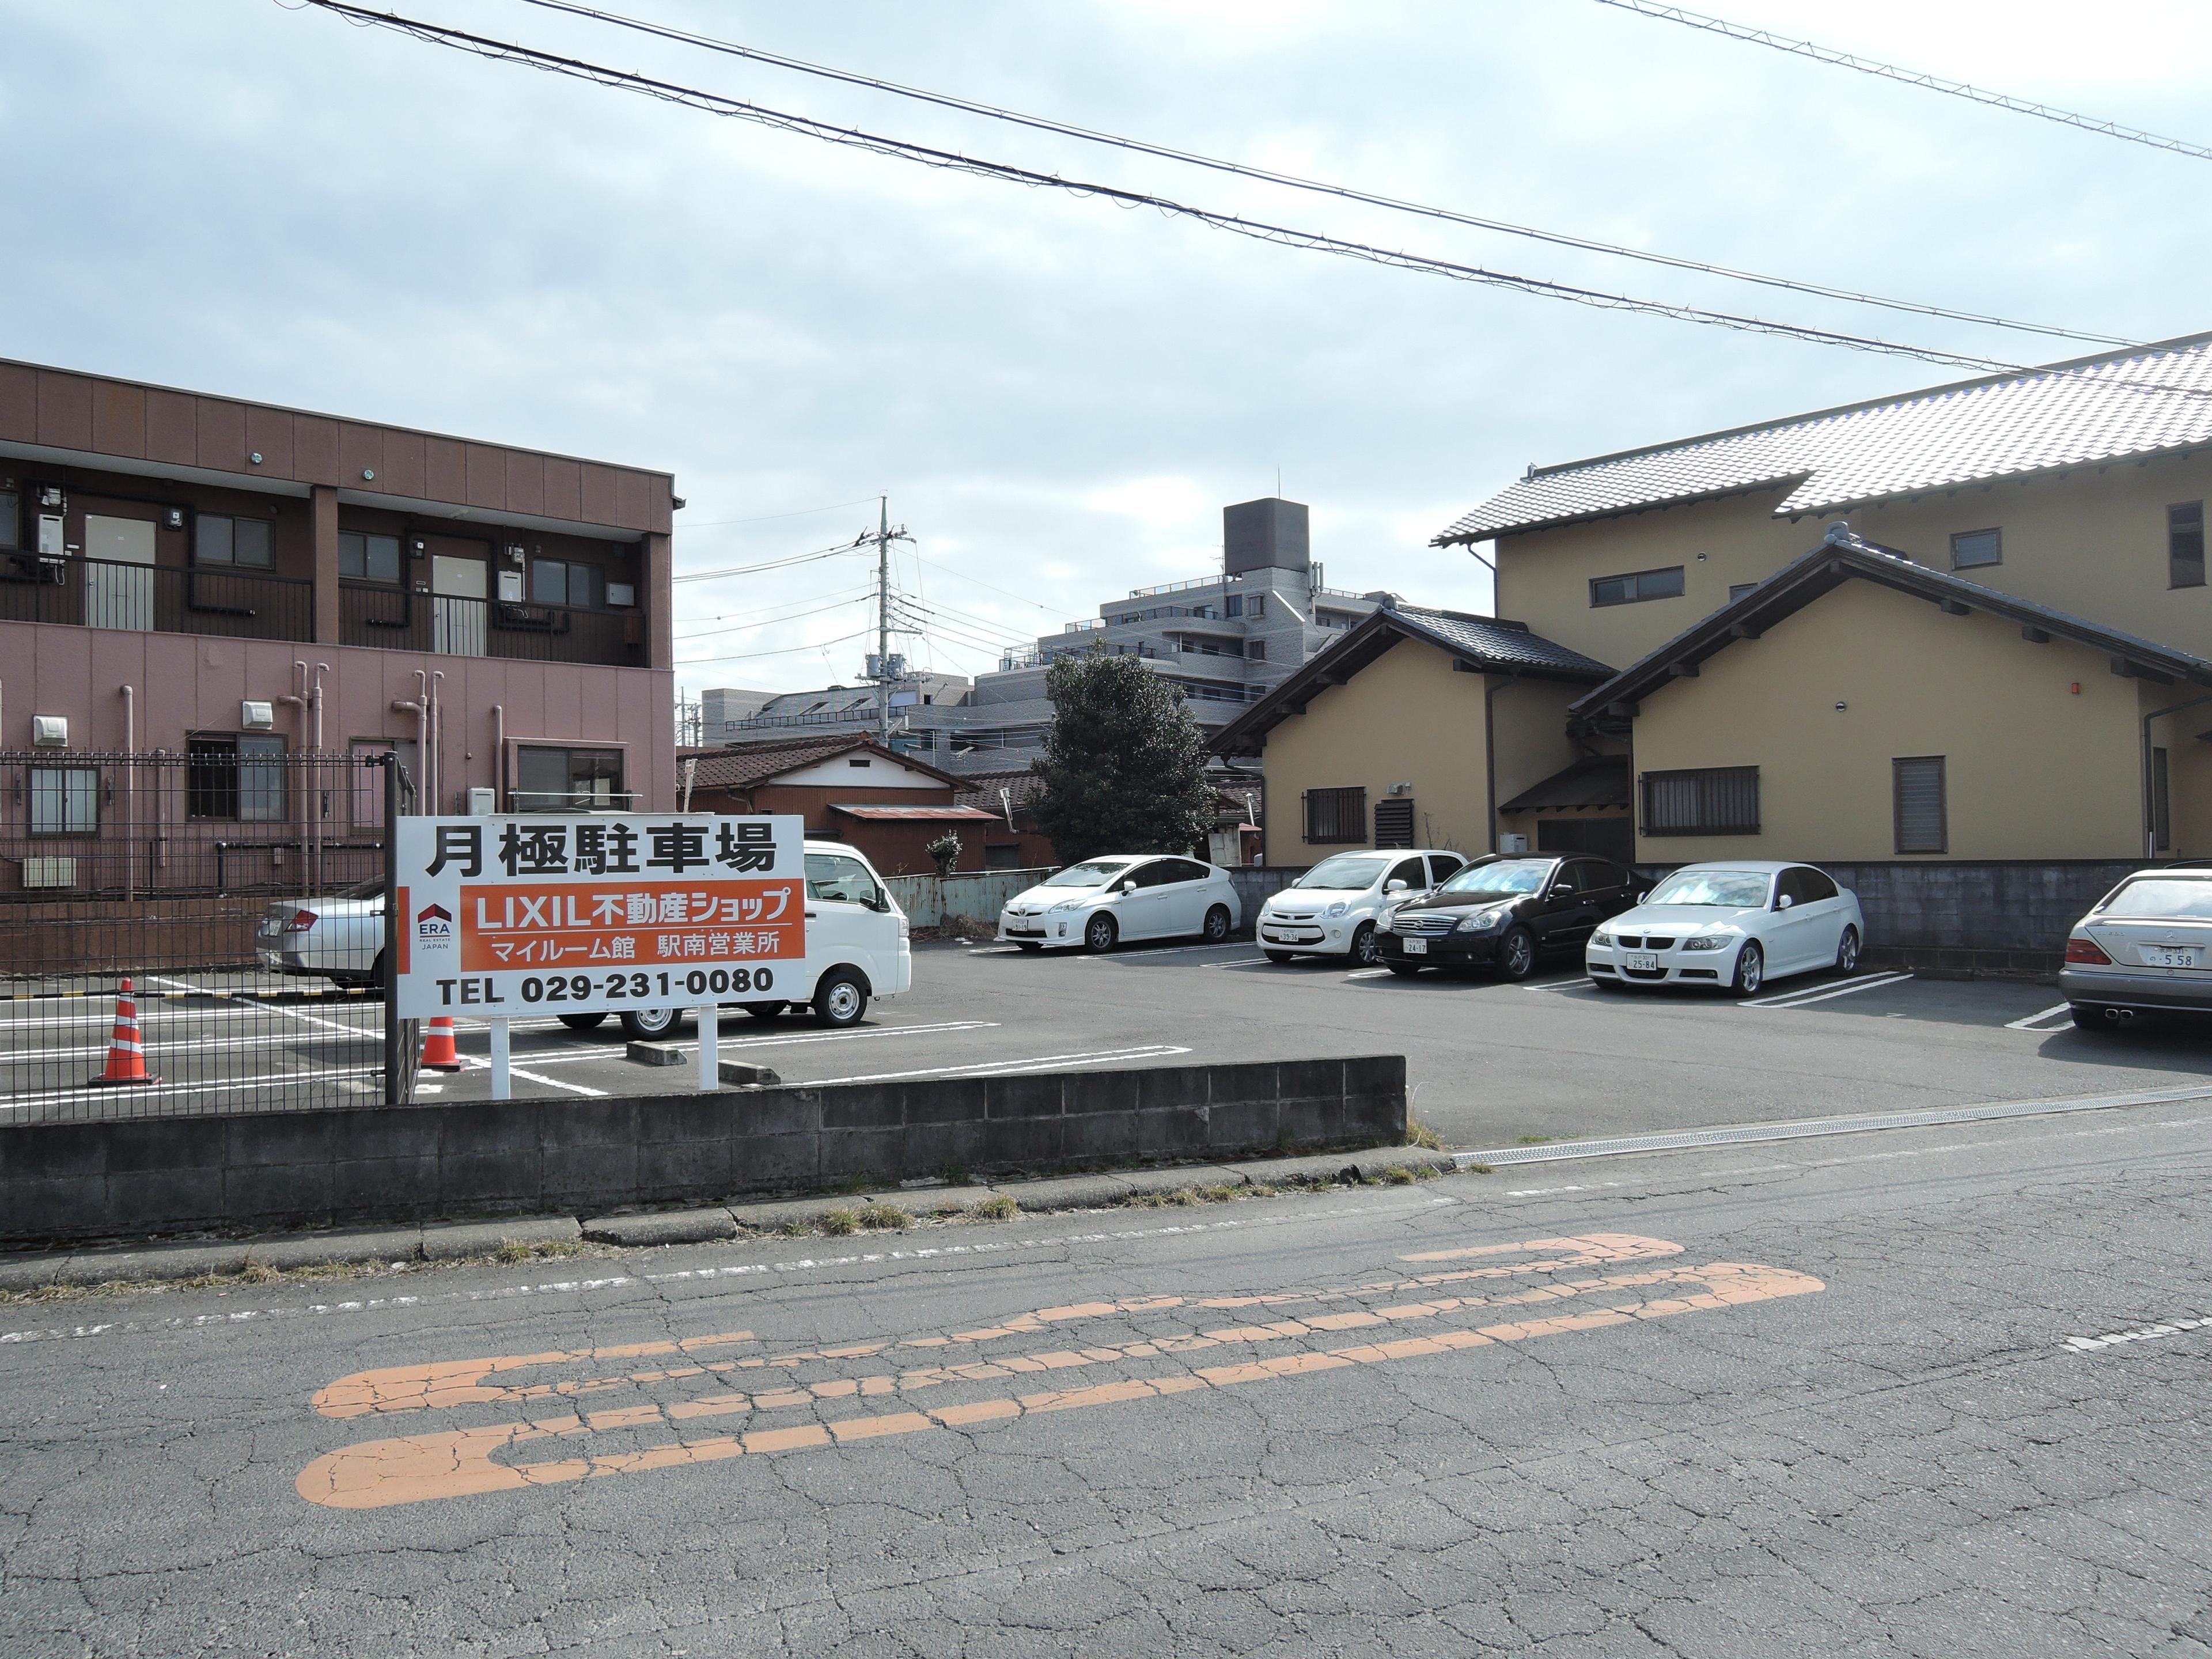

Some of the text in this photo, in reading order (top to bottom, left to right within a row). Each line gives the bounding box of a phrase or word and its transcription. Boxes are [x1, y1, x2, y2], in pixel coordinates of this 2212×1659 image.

[426, 823, 777, 877] 月極駐車場
[477, 887, 791, 929] LIXIL不動産ショップ
[419, 923, 450, 934] ERA
[491, 931, 780, 962] マイルーム館 駅南営業所
[1633, 960, 1654, 969] 25-84
[436, 967, 774, 1006] TEL 029-231-0080
